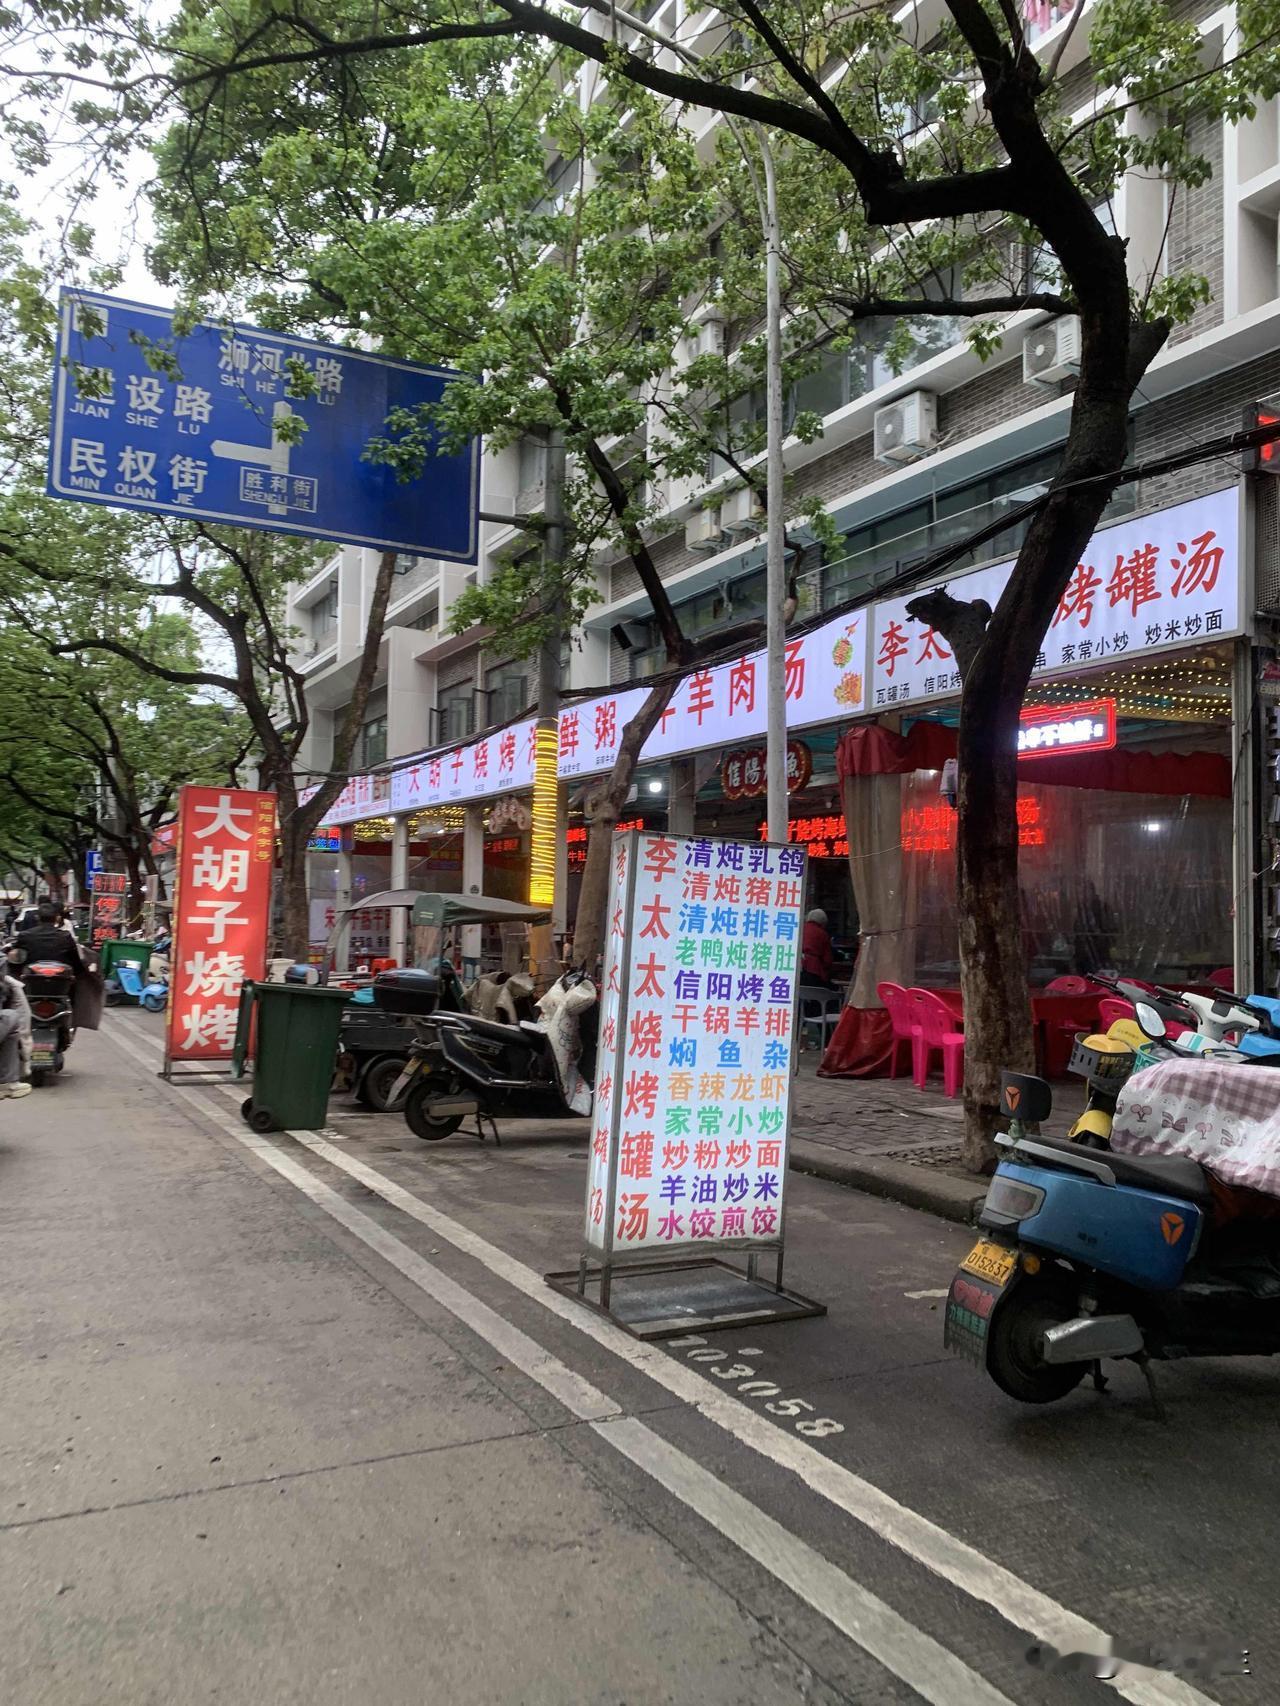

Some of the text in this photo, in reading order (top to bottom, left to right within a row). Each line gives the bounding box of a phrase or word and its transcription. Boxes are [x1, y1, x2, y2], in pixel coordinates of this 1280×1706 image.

[219, 373, 245, 389] SHI
[255, 380, 277, 395] HE
[69, 402, 200, 435] JIAN SHE LU
[68, 437, 208, 494] 民权街
[70, 475, 195, 506] MIN QUAN JIE
[245, 472, 312, 497] 胜利街
[876, 682, 911, 705] 瓦罐汤
[1061, 630, 1130, 665] 家常小炒
[1144, 608, 1224, 646] 炒米炒面
[727, 751, 801, 788] 信陽魚
[684, 837, 805, 878] 清炖乳鸽
[681, 870, 801, 909] 清炖猪肚
[180, 795, 254, 1051] 大胡子烧烤
[678, 903, 799, 941] 清炖排骨
[674, 937, 796, 974] 老鸭炖猪肚
[673, 970, 792, 1006] 信阳烤鱼
[671, 1004, 790, 1037] 干锅羊排
[617, 836, 679, 1243] 李太太烧烤罐汤
[668, 1037, 789, 1069] 焖鱼杂
[666, 1071, 787, 1104] 香辣龙虾
[664, 1105, 784, 1137] 家常小炒
[661, 1139, 781, 1171] 炒粉炒面
[659, 1171, 780, 1205] 羊油炒米
[657, 1206, 778, 1240] 水饺煎饺
